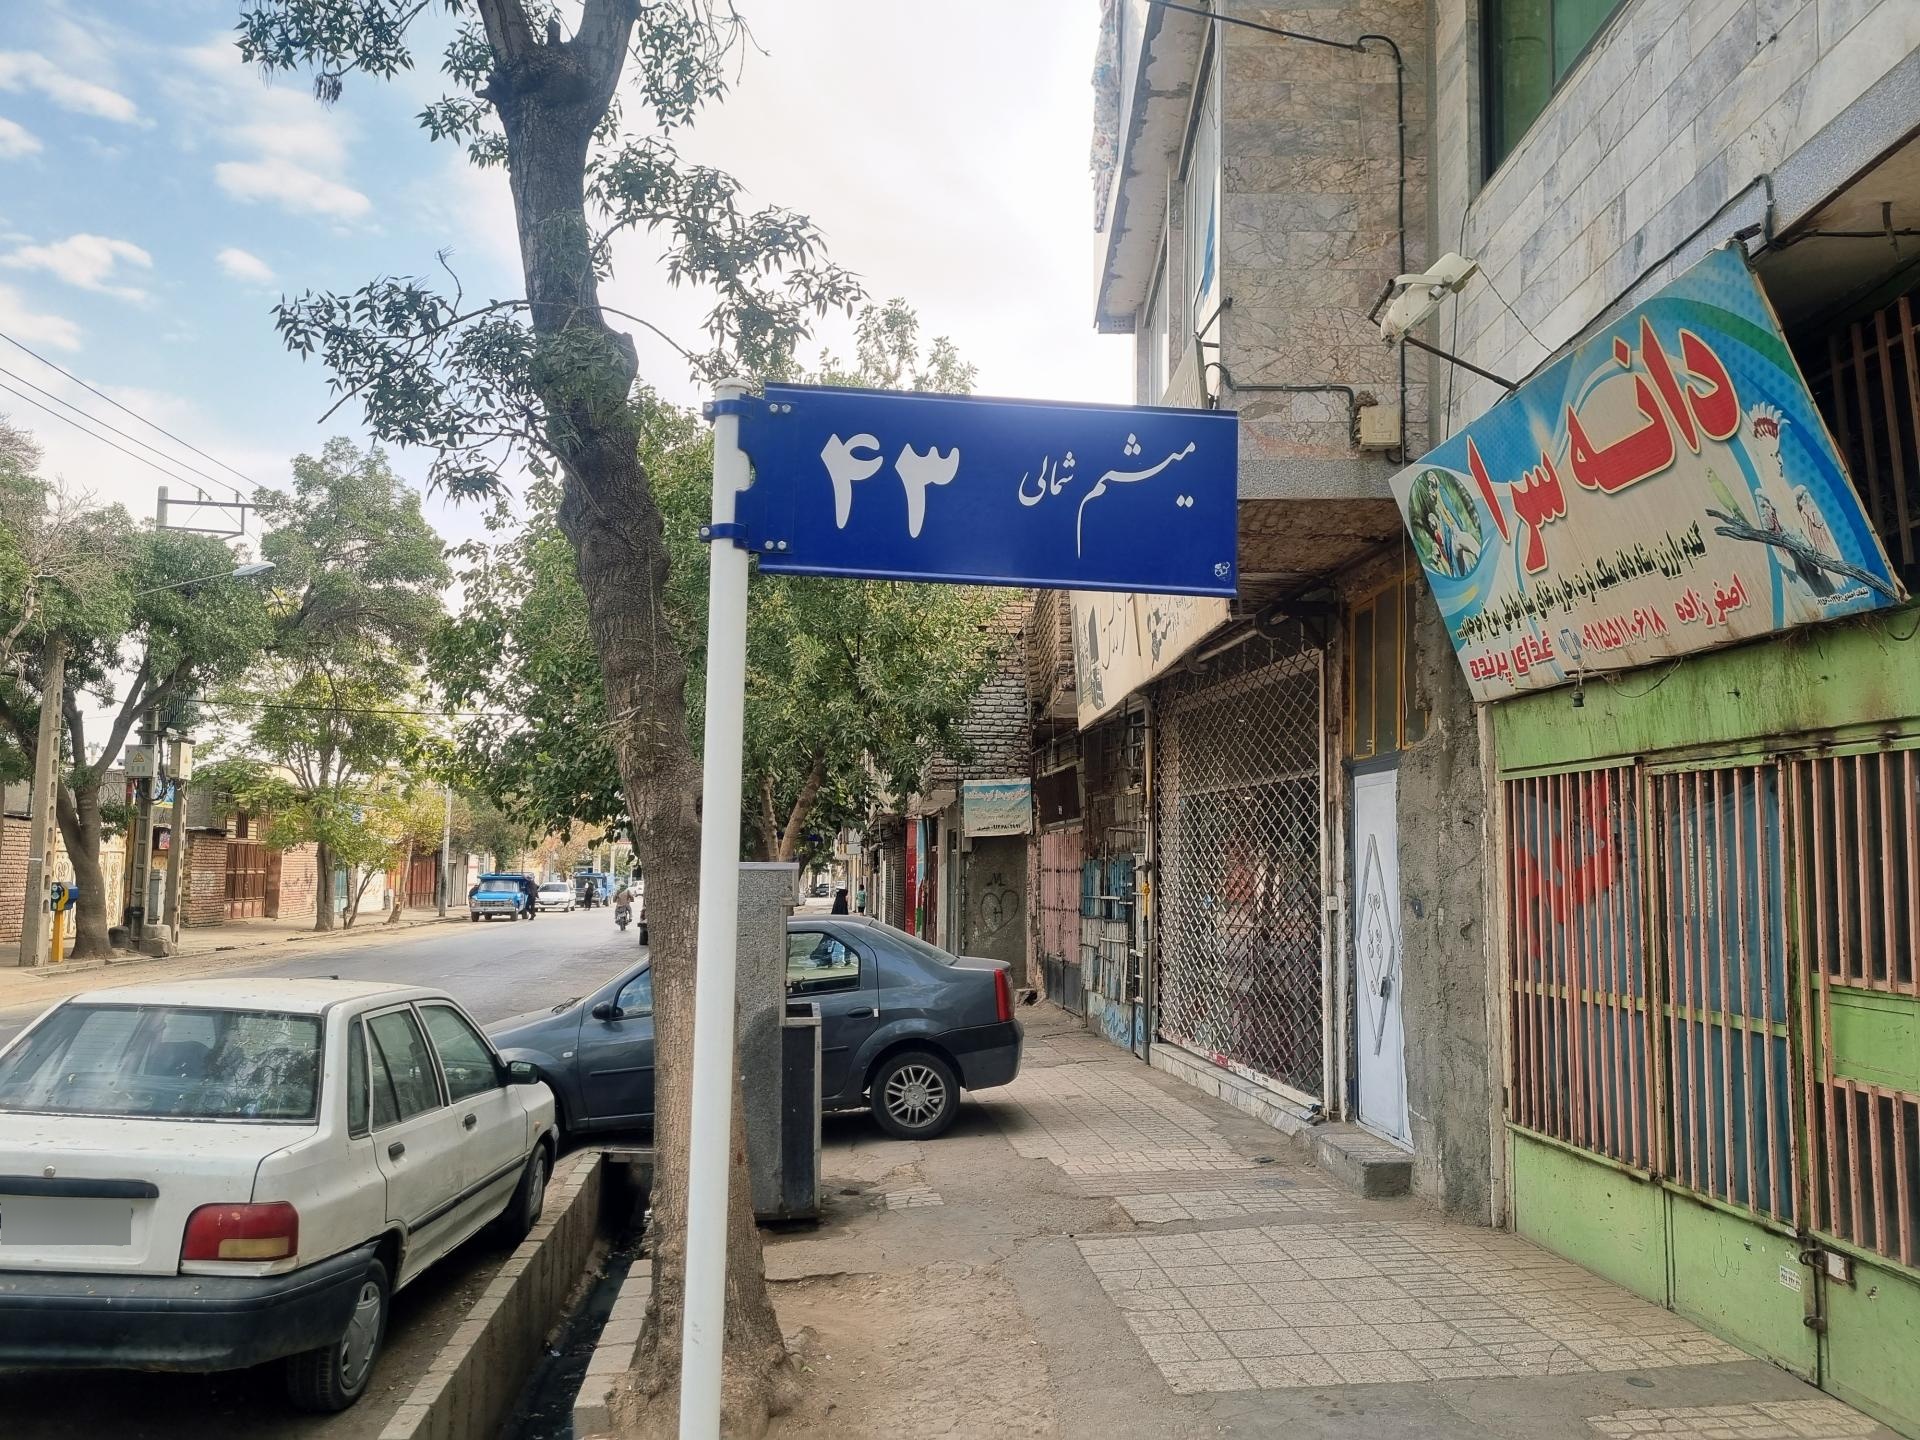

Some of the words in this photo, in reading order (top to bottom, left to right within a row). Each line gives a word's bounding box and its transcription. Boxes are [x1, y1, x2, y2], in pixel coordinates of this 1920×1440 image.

[1567, 315, 1741, 492] دانه
[820, 433, 960, 539] ۴۳
[1018, 451, 1076, 506] شمالی
[1076, 432, 1197, 559] میثم
[1467, 436, 1567, 575] سرا
[1680, 519, 1706, 569] گندم
[1674, 587, 1714, 627] زاده
[1714, 572, 1750, 624] اصغر
[1469, 648, 1513, 684] پرنده
[1511, 630, 1554, 676] غذای
